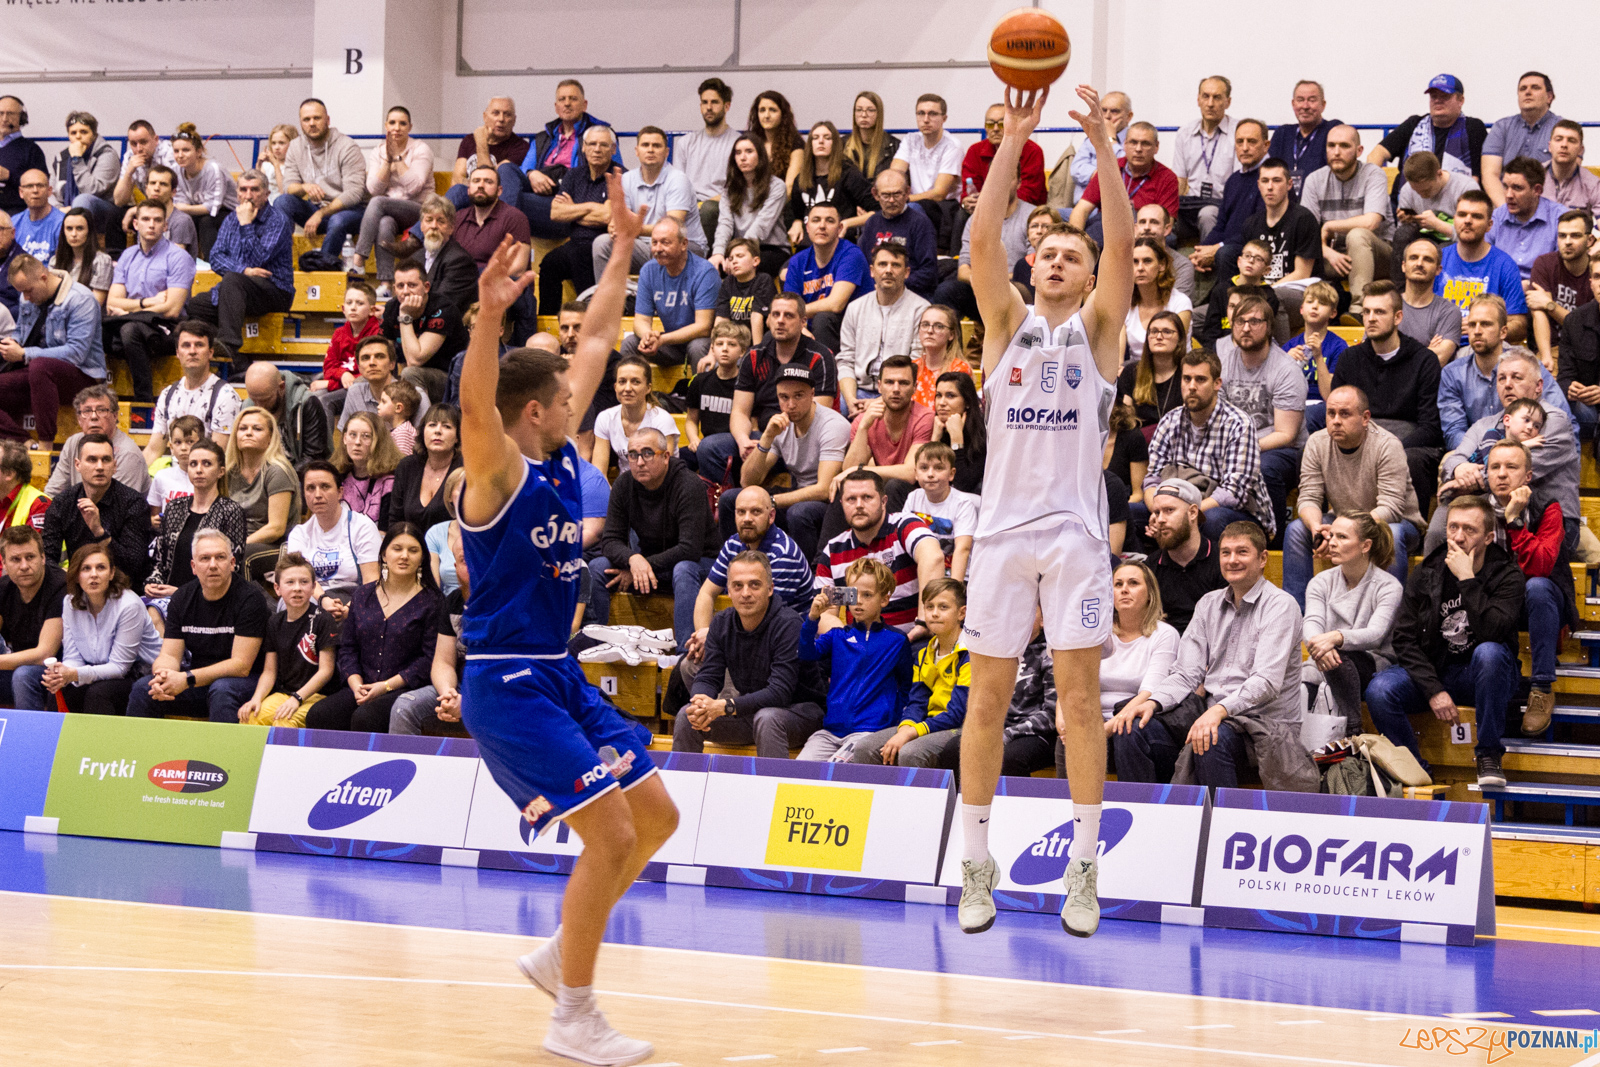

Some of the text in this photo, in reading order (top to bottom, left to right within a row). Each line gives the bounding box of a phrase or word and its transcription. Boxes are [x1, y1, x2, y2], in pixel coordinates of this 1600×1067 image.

[344, 48, 363, 75] B
[311, 287, 317, 298] 9
[653, 290, 689, 307] FOX
[247, 324, 258, 335] 15
[1040, 361, 1059, 394] 5
[700, 394, 733, 415] PUM
[1006, 407, 1079, 425] BIOFARM
[1081, 597, 1100, 629] 5
[607, 679, 613, 692] 1
[1456, 726, 1466, 741] 9
[79, 757, 137, 781] Frytki
[153, 768, 224, 783] FARM FRITES
[142, 794, 225, 808] the fresh taste of the land
[326, 780, 393, 807] atrem
[783, 806, 815, 823] pro
[1222, 831, 1459, 886] BIOFARM
[1238, 878, 1436, 902] POLSKI PRODUCENT LEKÓW
